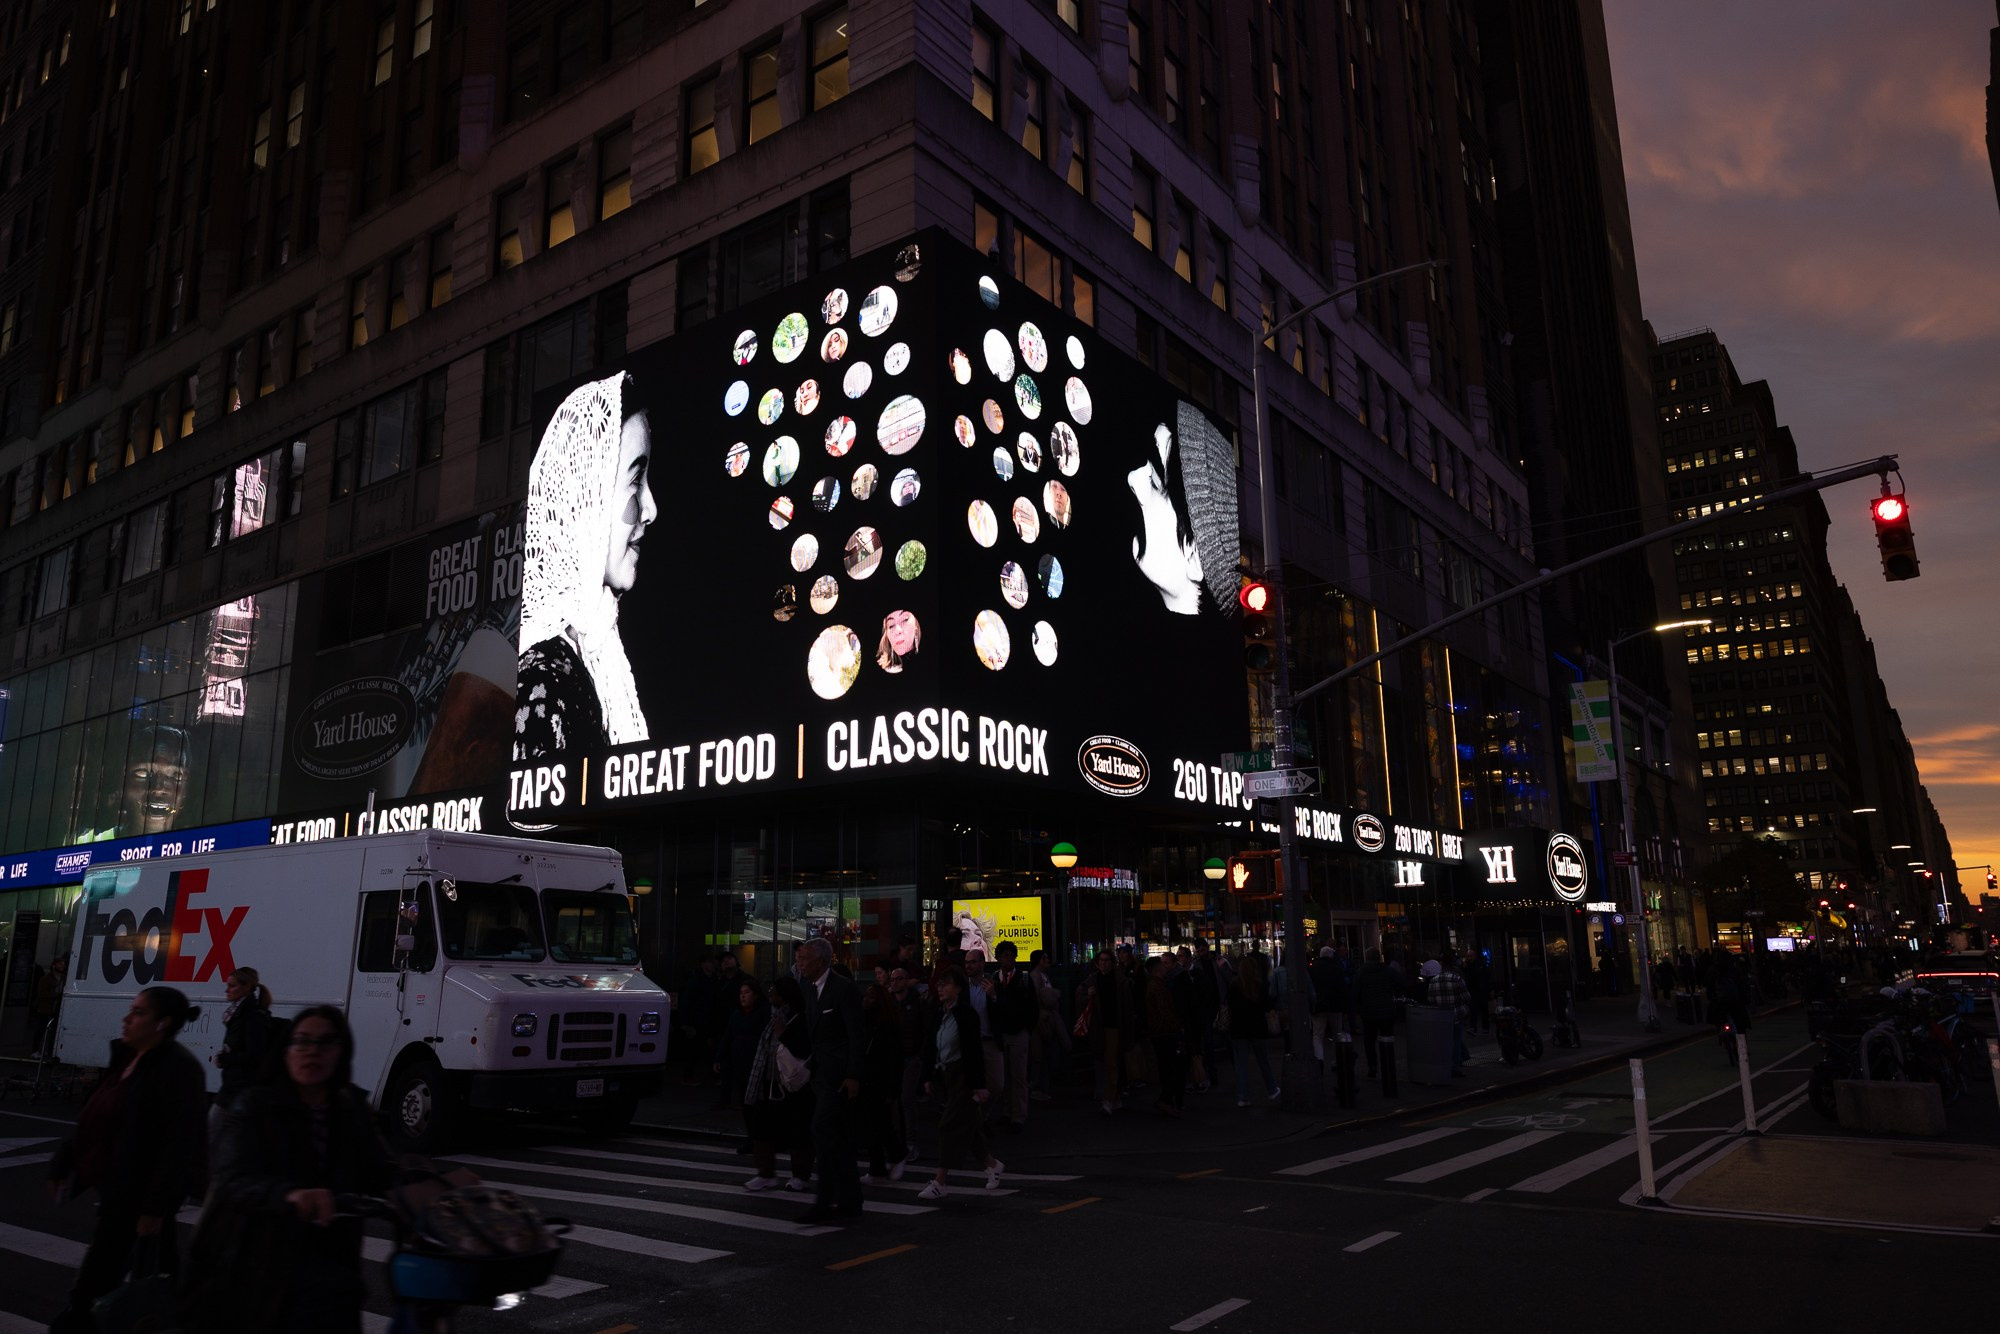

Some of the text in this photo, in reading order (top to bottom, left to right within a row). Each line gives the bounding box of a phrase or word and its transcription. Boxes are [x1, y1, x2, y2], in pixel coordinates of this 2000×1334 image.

[494, 522, 526, 557] CLA
[428, 535, 482, 582] GREAT
[425, 570, 478, 620] FOOD
[491, 553, 523, 601] RO
[312, 711, 398, 749] Yard House
[827, 707, 1050, 777] CLASSIC ROCK
[604, 733, 776, 800] GREAT FOOD
[1090, 752, 1141, 779] Yard House
[1234, 755, 1245, 770] W
[1248, 754, 1260, 770] 41
[510, 763, 567, 811] TAPS
[1172, 758, 1208, 804] 260
[1254, 775, 1308, 791] ONE WAY
[295, 817, 336, 843] FOOD
[432, 796, 484, 833] ROCK
[1312, 808, 1343, 843] ROCK
[120, 838, 216, 862] SPORT FOR LIFE
[1394, 824, 1411, 853] 260
[1410, 828, 1434, 856] TAPS
[10, 862, 28, 879] LIFE
[56, 854, 90, 868] CHAMPS
[1478, 845, 1517, 884] YH
[75, 868, 251, 986] FedEx
[998, 928, 1039, 938] PLURIBUS
